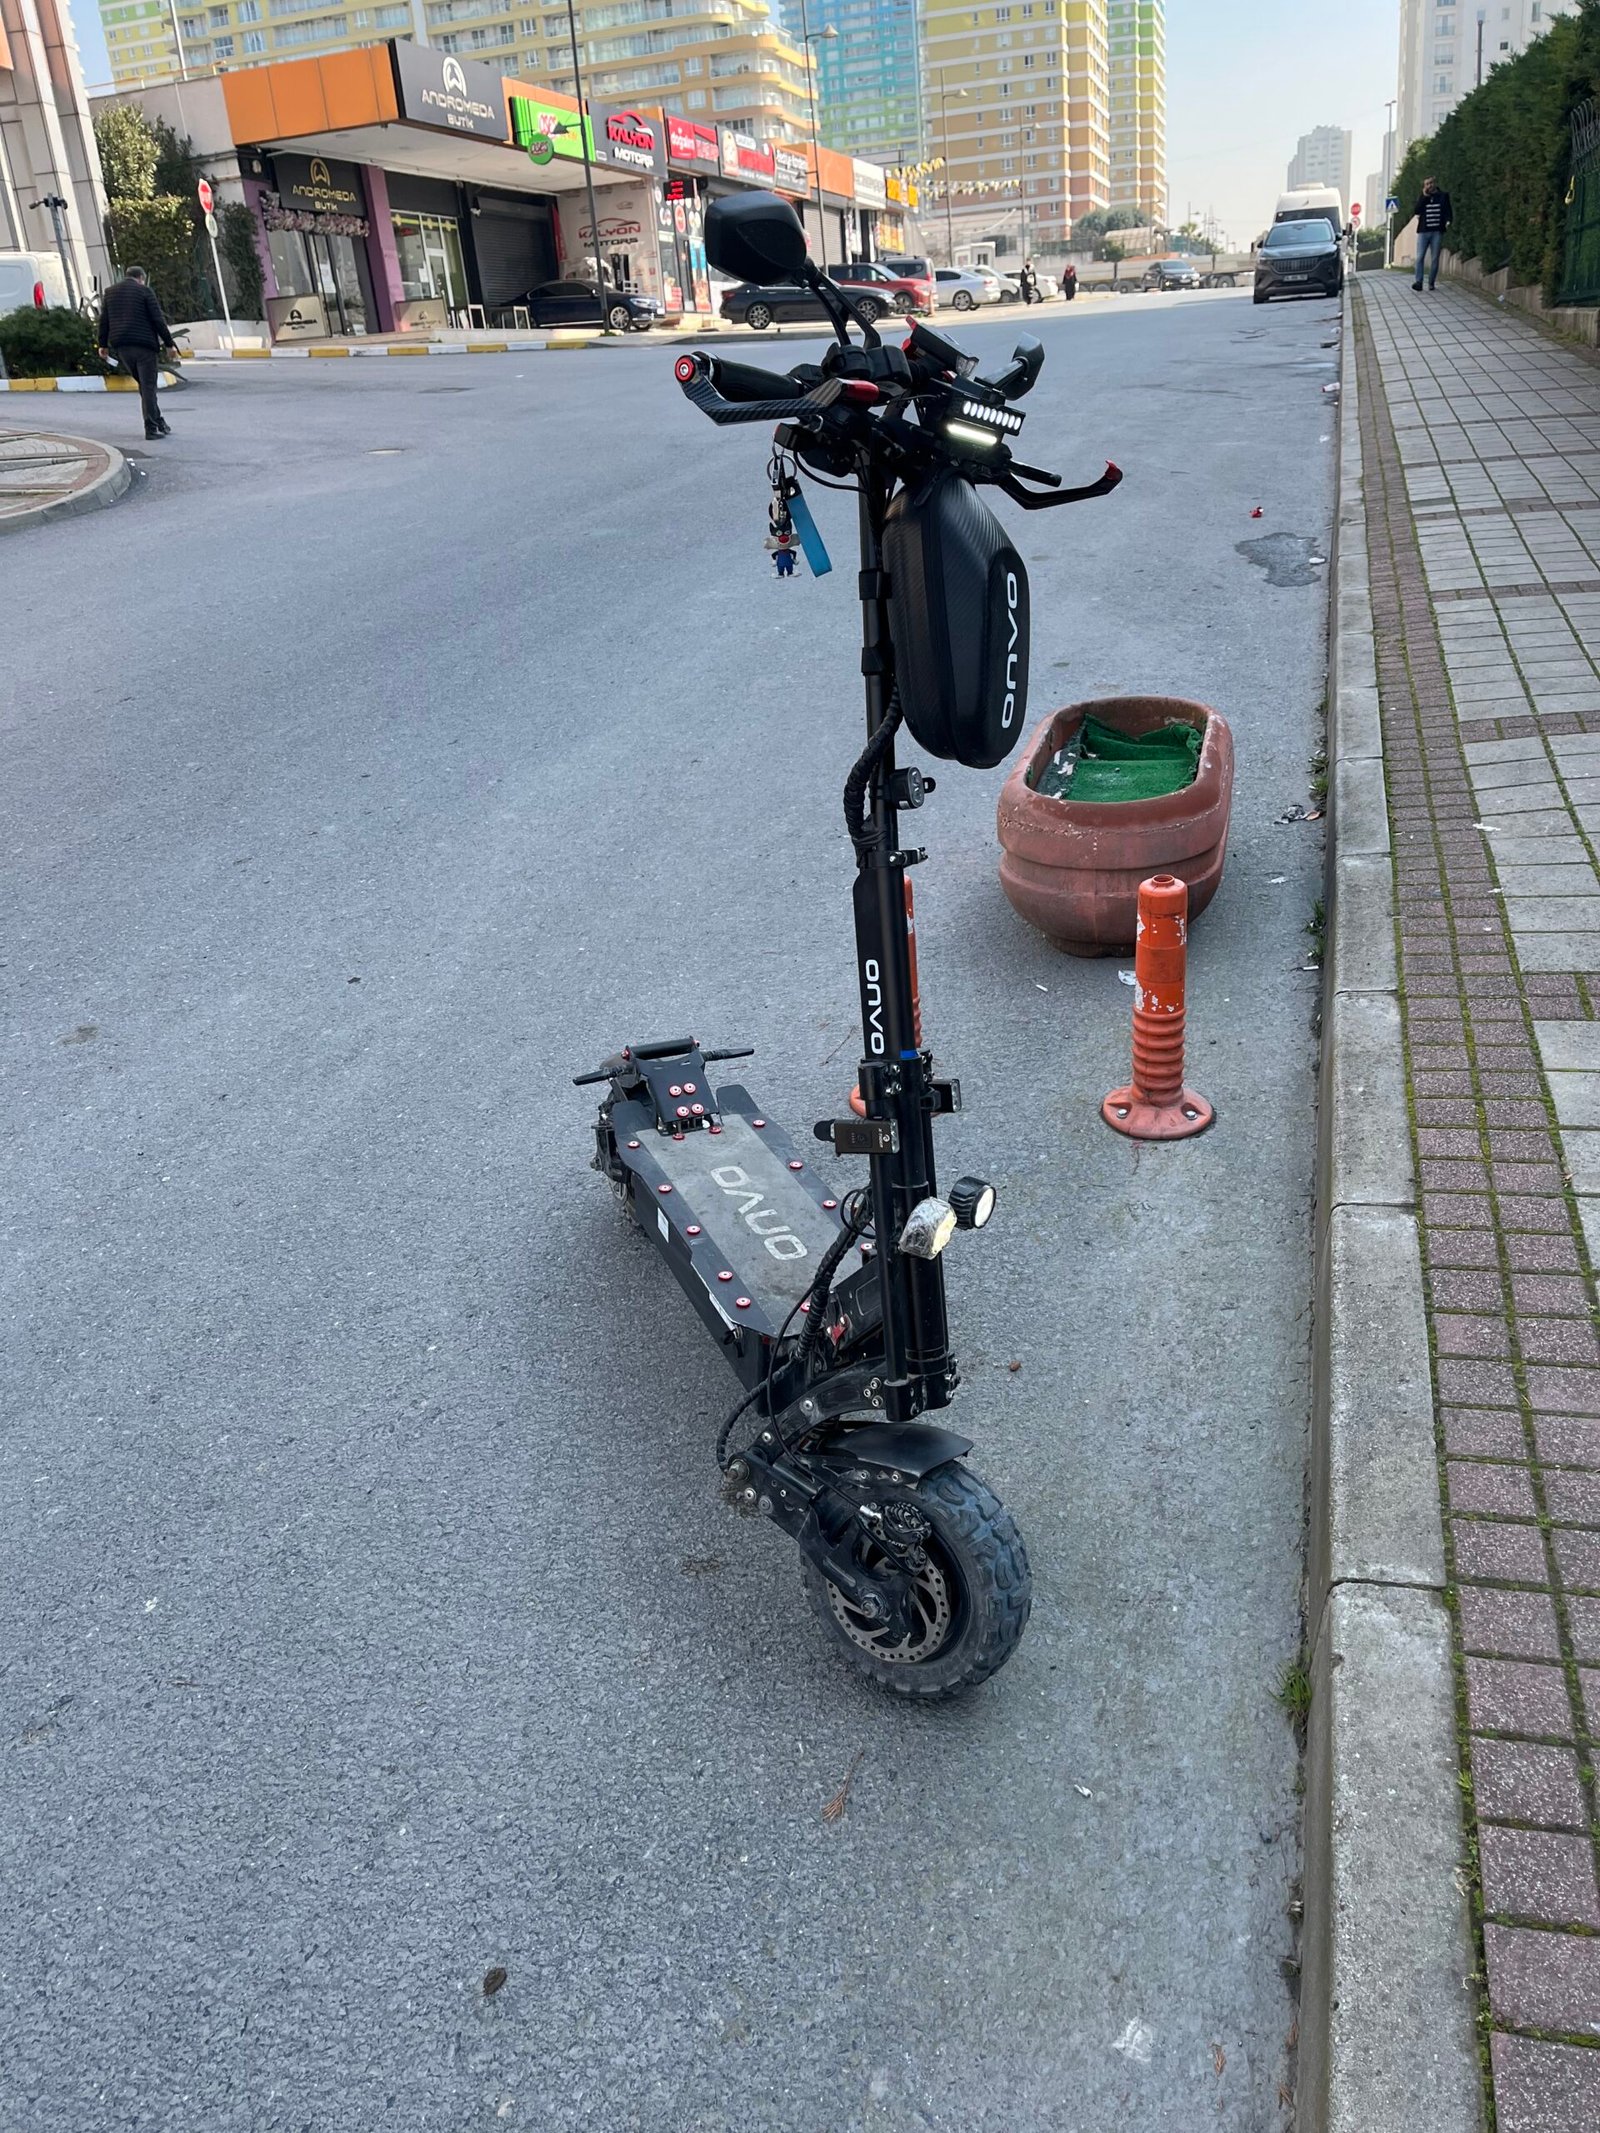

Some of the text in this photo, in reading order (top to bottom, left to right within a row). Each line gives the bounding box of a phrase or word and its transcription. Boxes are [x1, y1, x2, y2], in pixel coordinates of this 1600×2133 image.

[420, 89, 495, 119] ANDROMEDA
[607, 126, 655, 151] KALYON
[613, 146, 654, 169] MOTORS
[292, 184, 357, 202] ANDROMEDA
